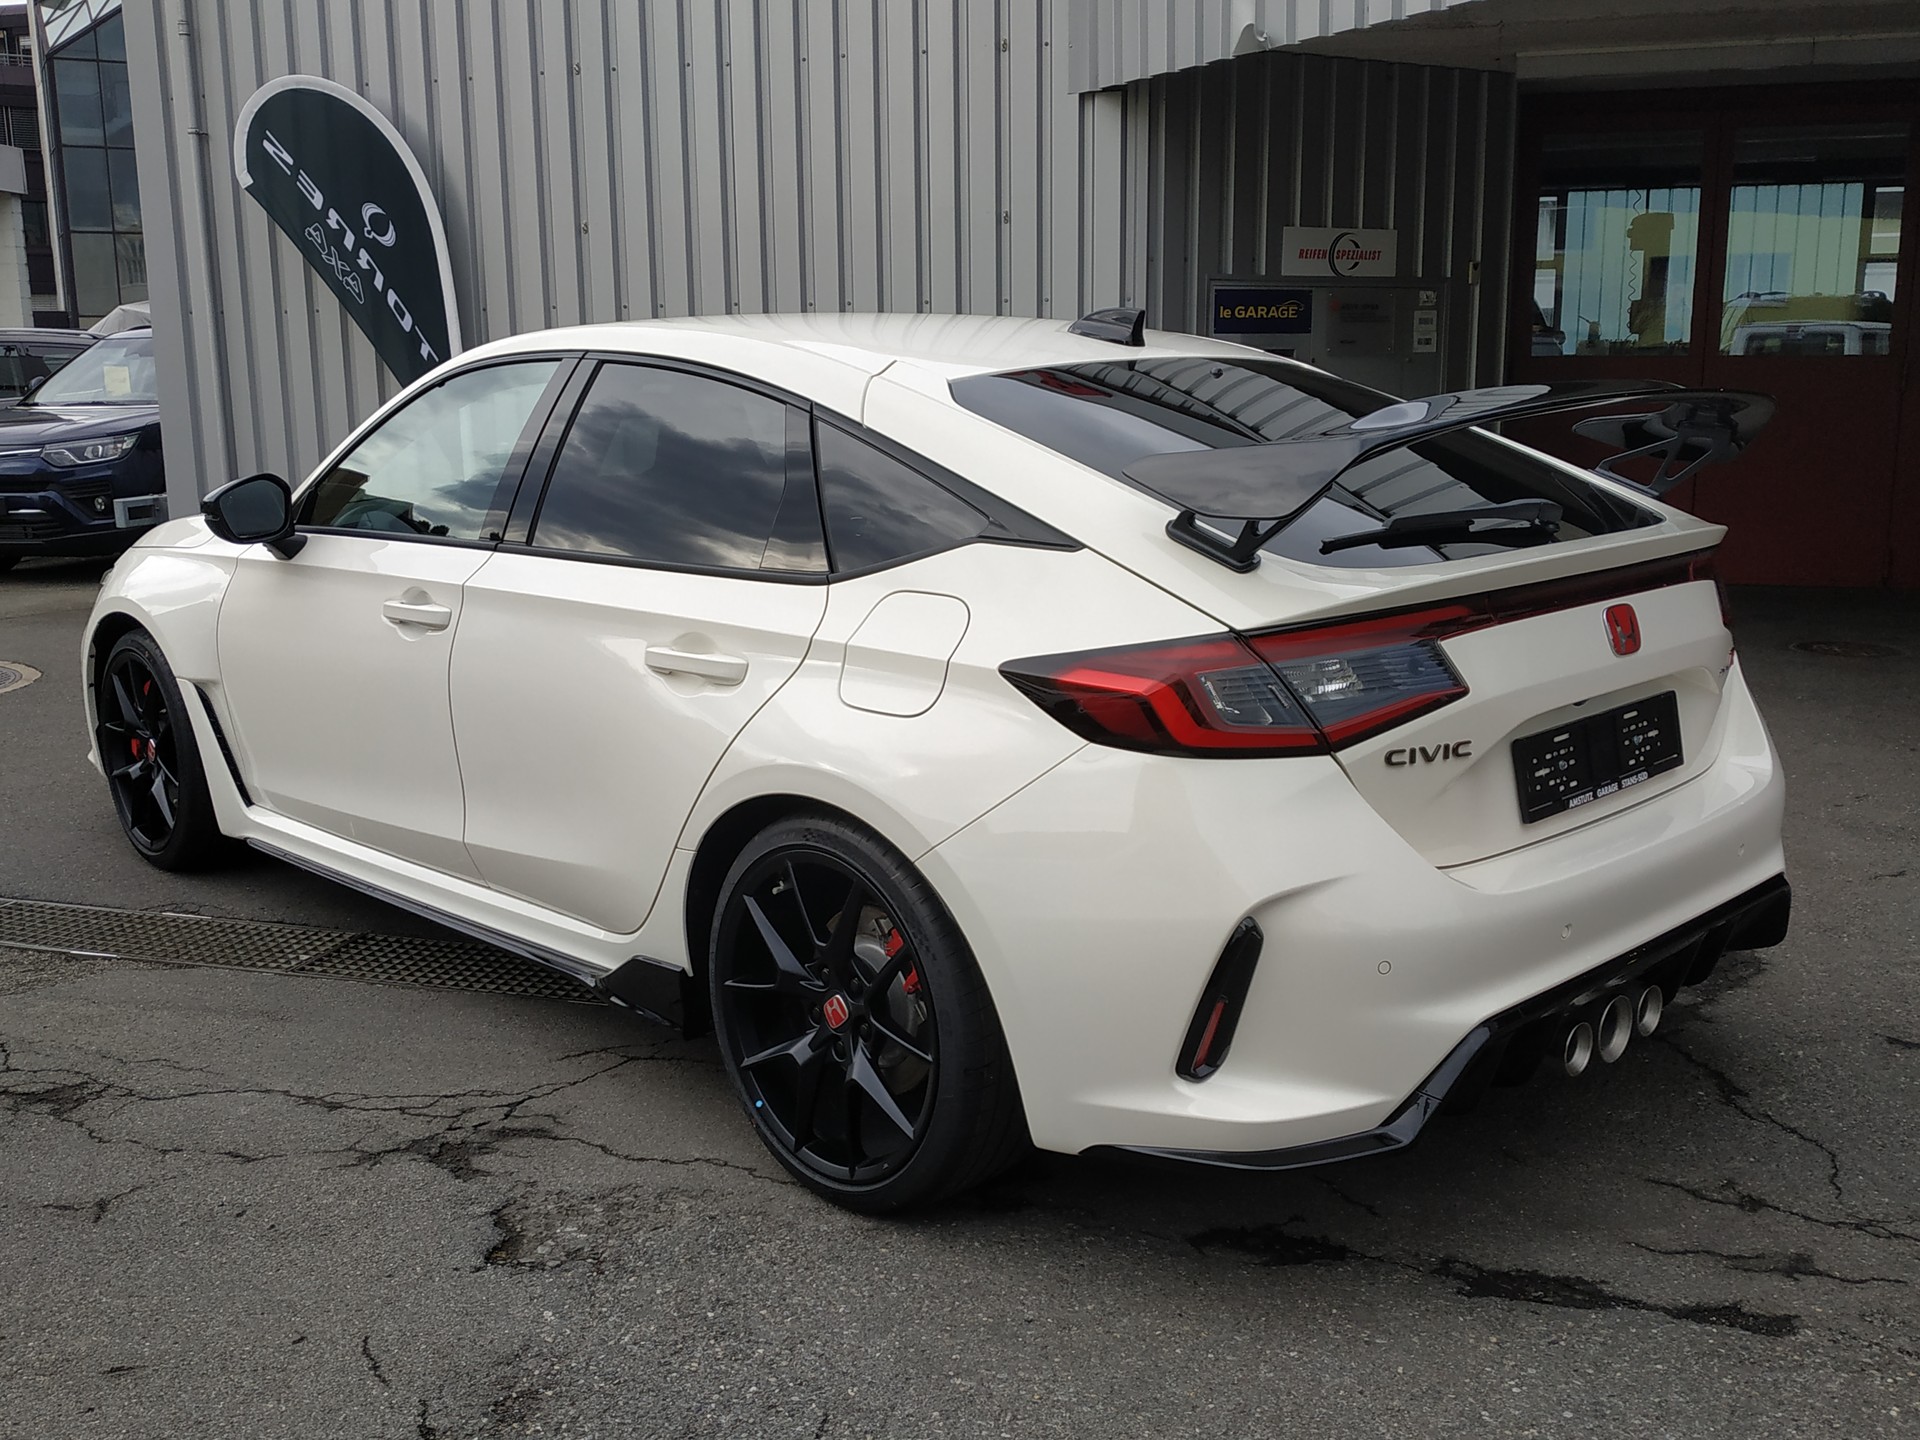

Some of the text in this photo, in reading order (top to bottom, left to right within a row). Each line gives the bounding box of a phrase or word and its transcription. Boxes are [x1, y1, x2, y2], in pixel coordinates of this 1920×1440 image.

[1298, 248, 1382, 261] REIFEN SPEZIALIST
[1220, 306, 1298, 318] le GARAGE
[1384, 740, 1472, 767] CIVIC
[1568, 792, 1594, 808] AMSTUTZ
[1597, 783, 1619, 797] GARAGE
